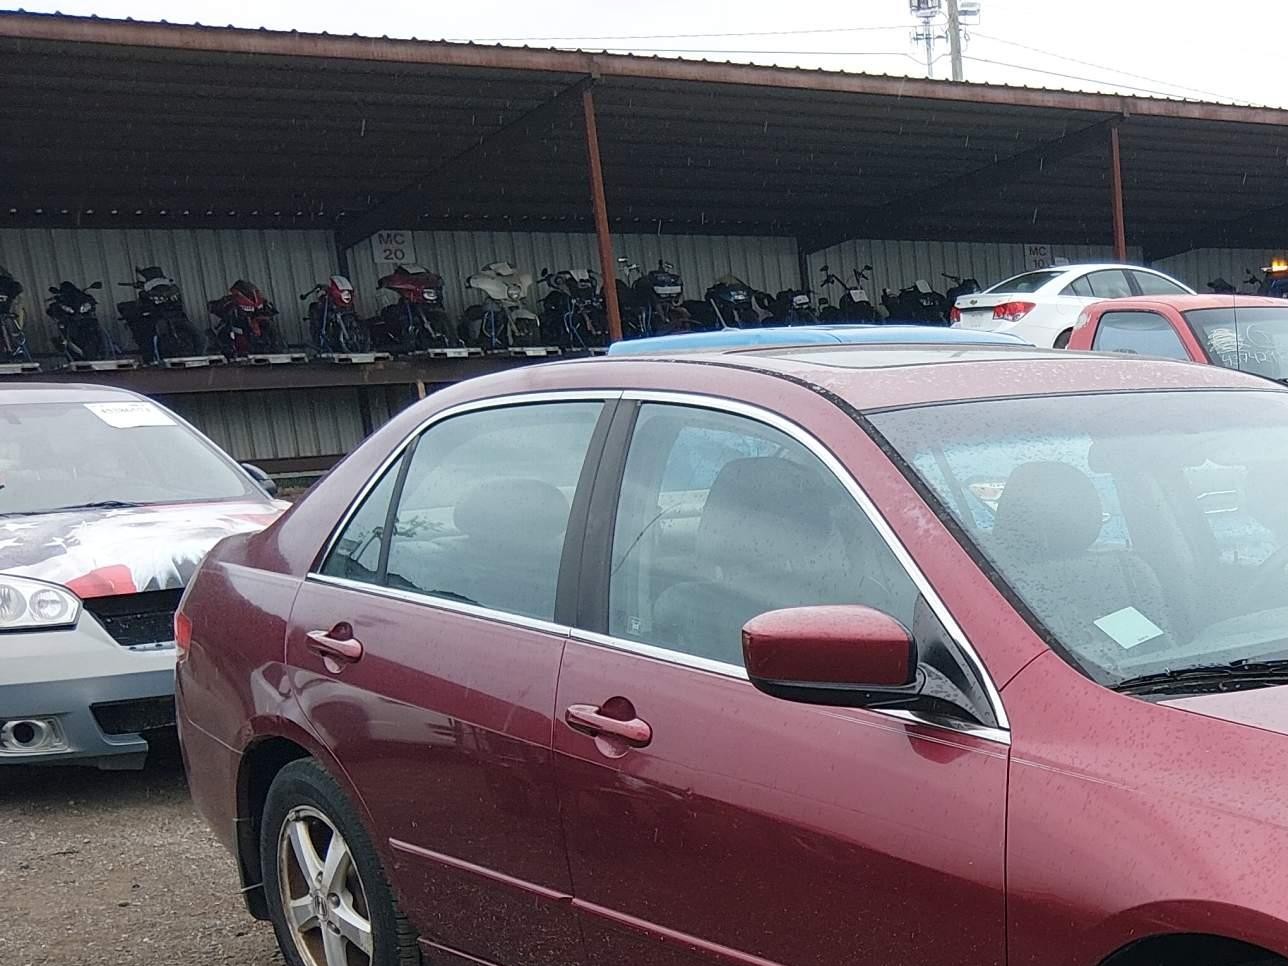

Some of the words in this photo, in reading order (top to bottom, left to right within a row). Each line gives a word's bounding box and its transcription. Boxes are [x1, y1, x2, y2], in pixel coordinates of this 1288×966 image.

[378, 232, 405, 245] MC
[383, 249, 405, 261] 20
[1029, 246, 1047, 256] MC
